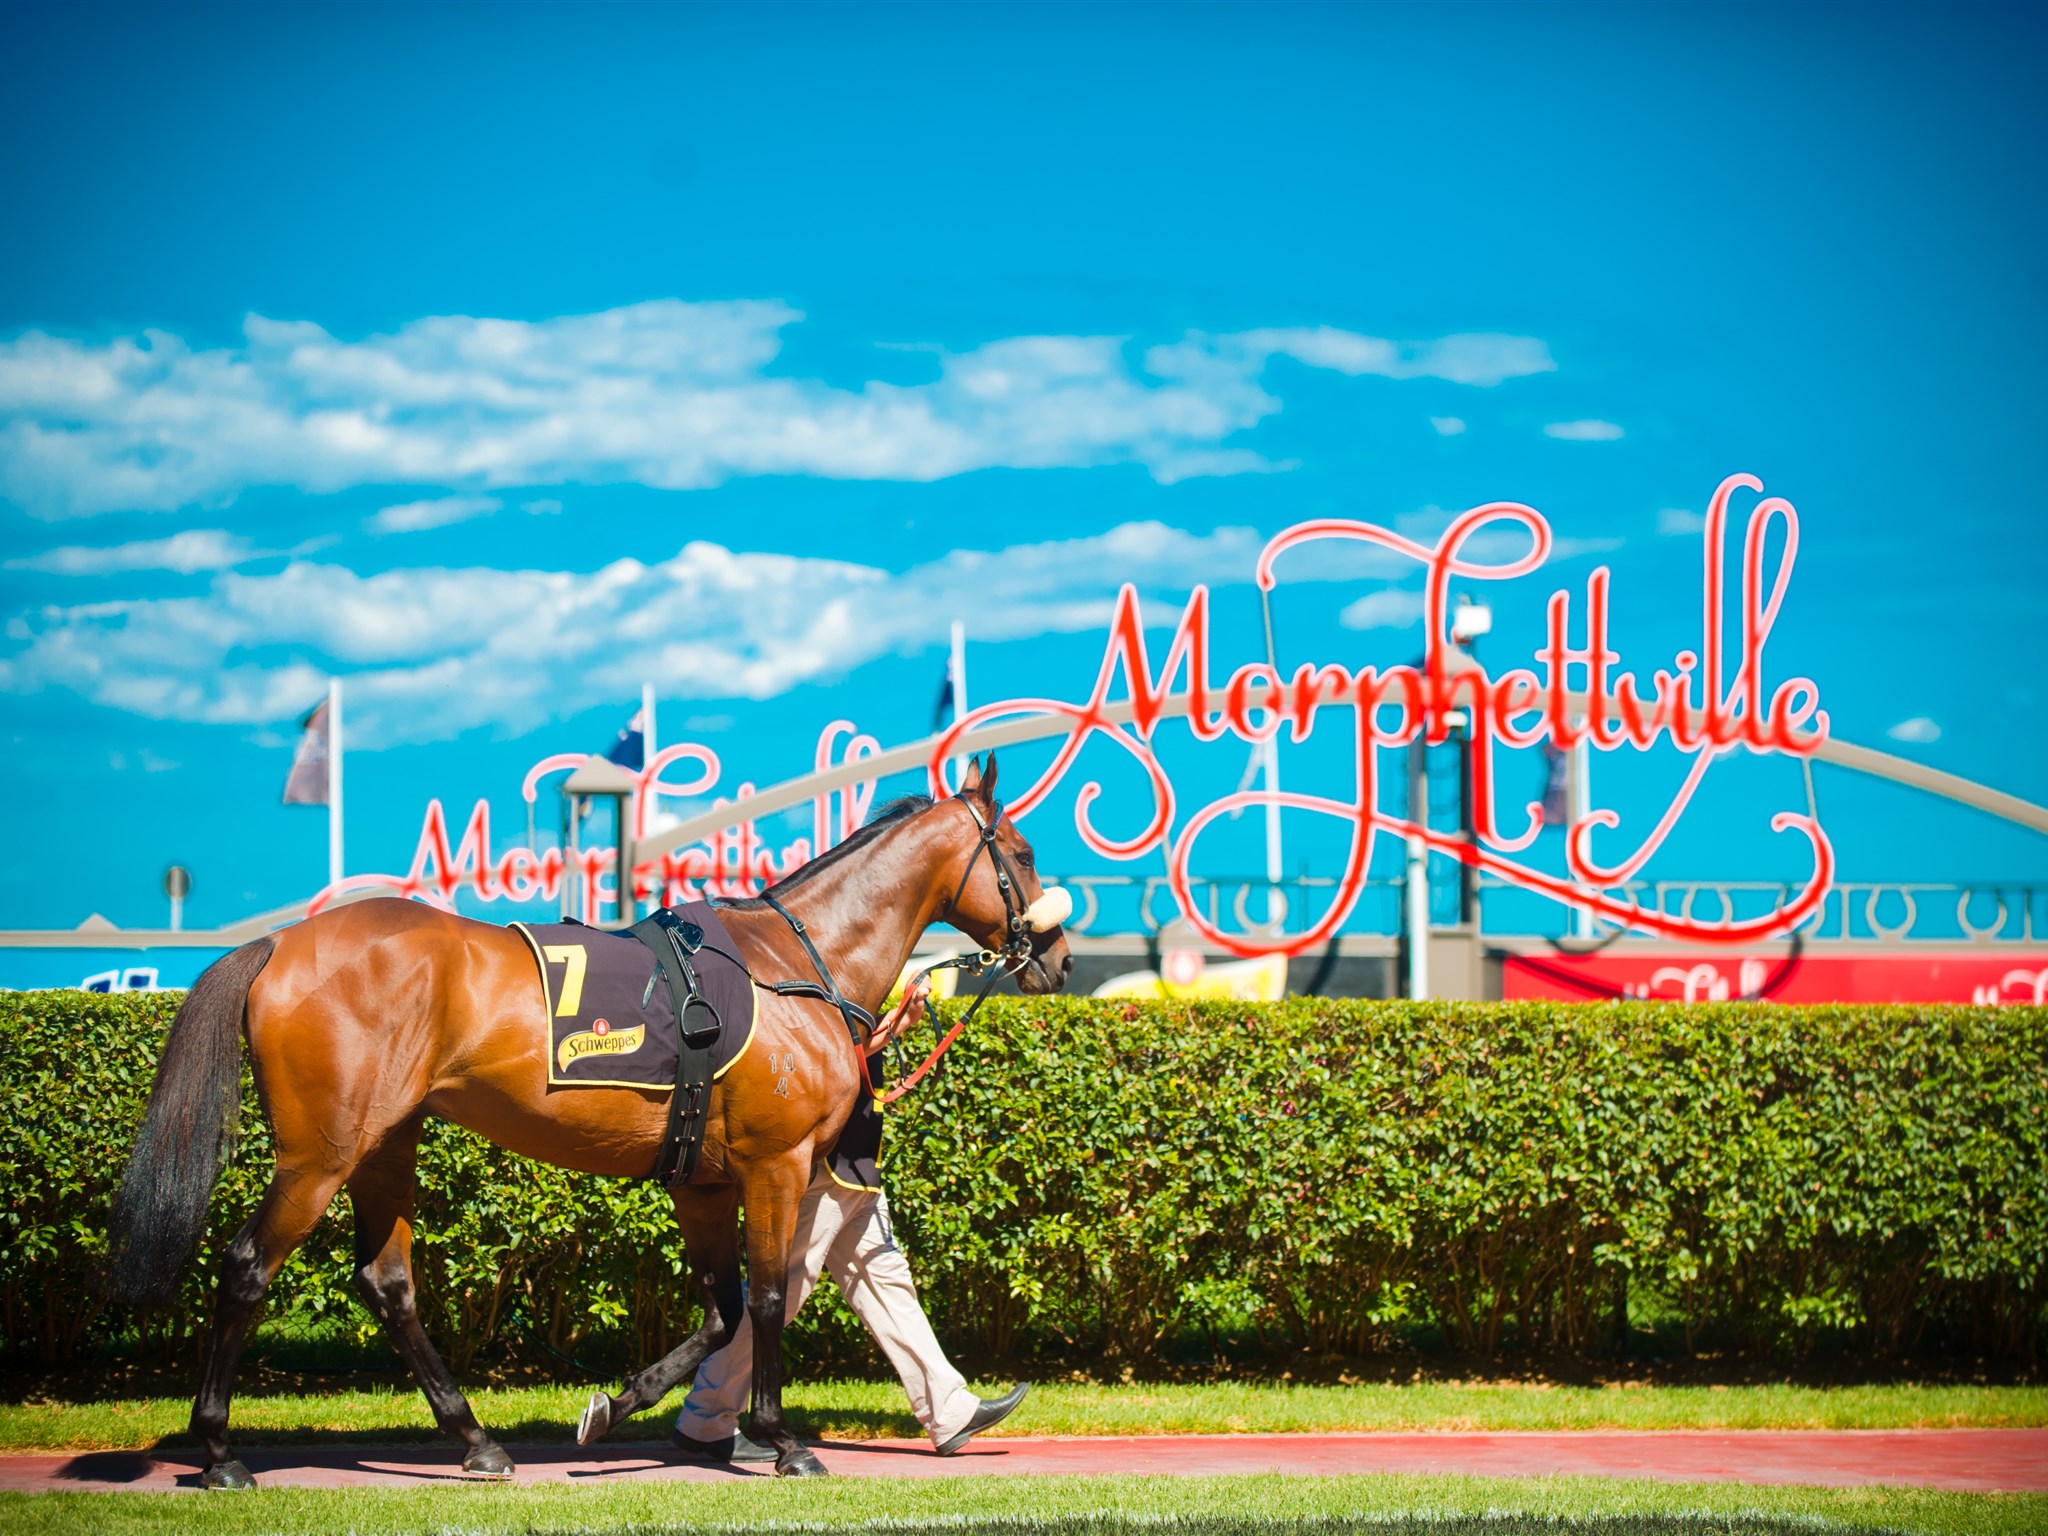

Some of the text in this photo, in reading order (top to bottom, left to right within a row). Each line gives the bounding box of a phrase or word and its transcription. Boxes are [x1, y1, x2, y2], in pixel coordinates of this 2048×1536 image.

[928, 472, 1834, 958] Morphettville
[543, 945, 587, 1017] 7
[568, 1034, 636, 1058] Schweppes
[774, 1076, 789, 1098] 4
